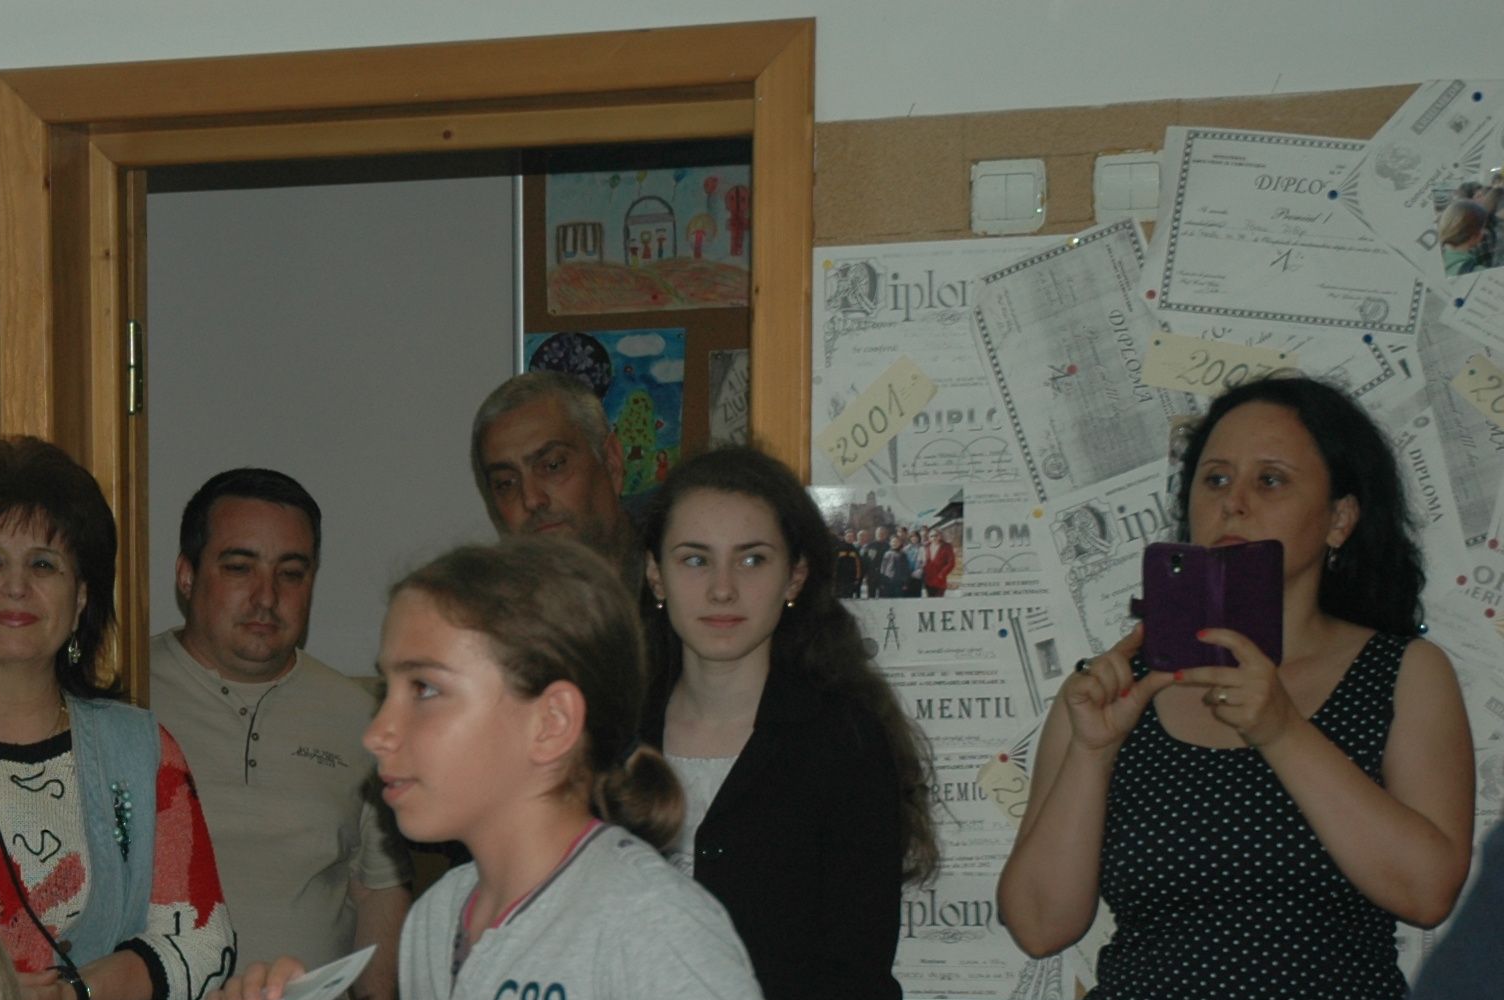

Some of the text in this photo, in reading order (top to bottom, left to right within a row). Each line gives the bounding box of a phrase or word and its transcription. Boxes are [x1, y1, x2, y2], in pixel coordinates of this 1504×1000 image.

[1255, 174, 1330, 196] DIPLO
[1409, 447, 1445, 524] DIPLOMA
[918, 606, 1041, 633] MENTIU
